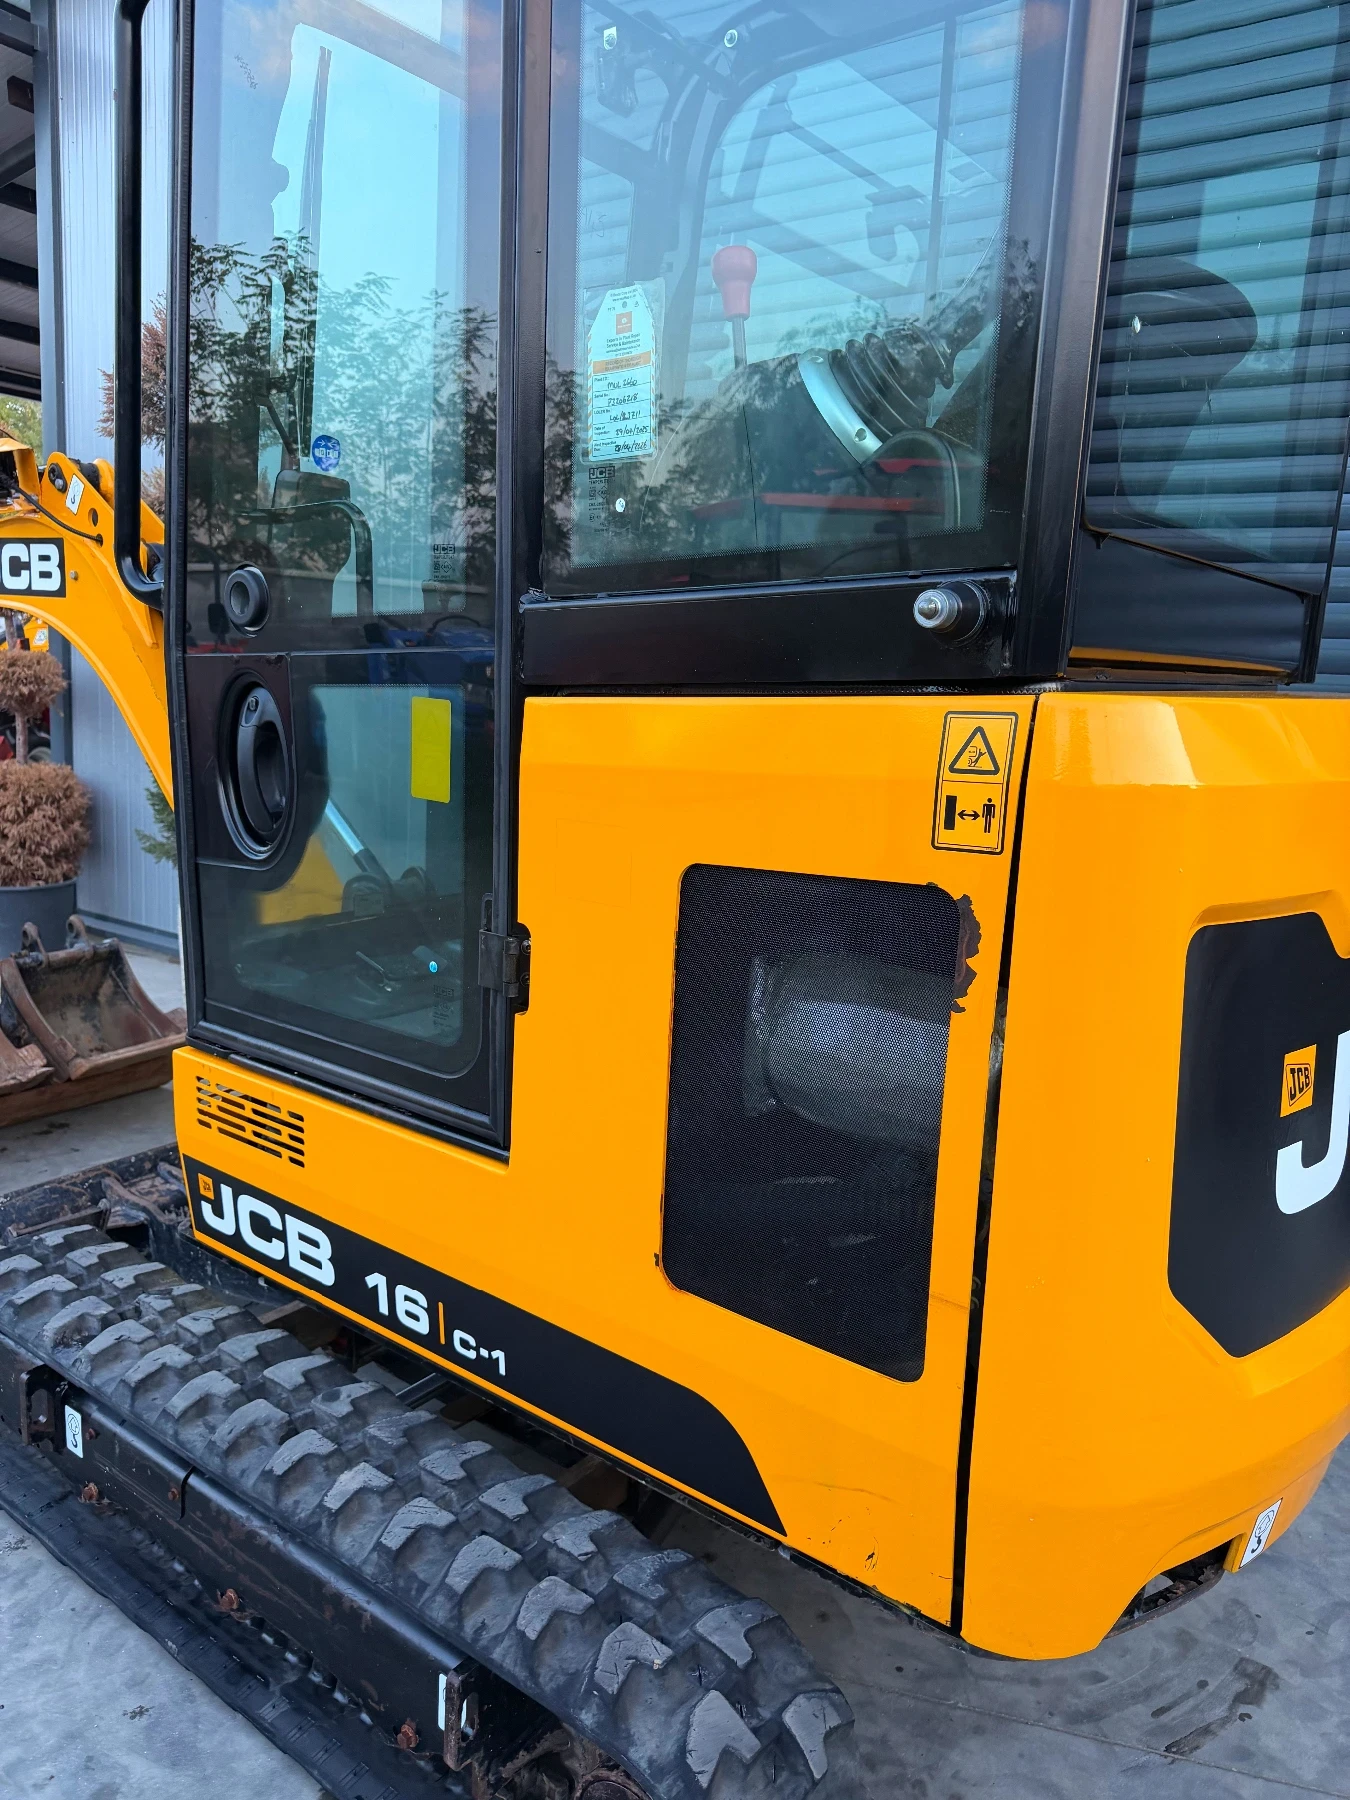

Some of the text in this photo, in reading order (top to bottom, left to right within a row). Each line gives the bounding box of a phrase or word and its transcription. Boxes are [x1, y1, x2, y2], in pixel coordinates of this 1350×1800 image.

[586, 466, 615, 479] JCB
[433, 544, 455, 554] JCB
[0, 543, 62, 592] CB
[1290, 1066, 1311, 1101] JCB
[201, 1183, 335, 1286] JCB
[365, 1272, 430, 1335] 16
